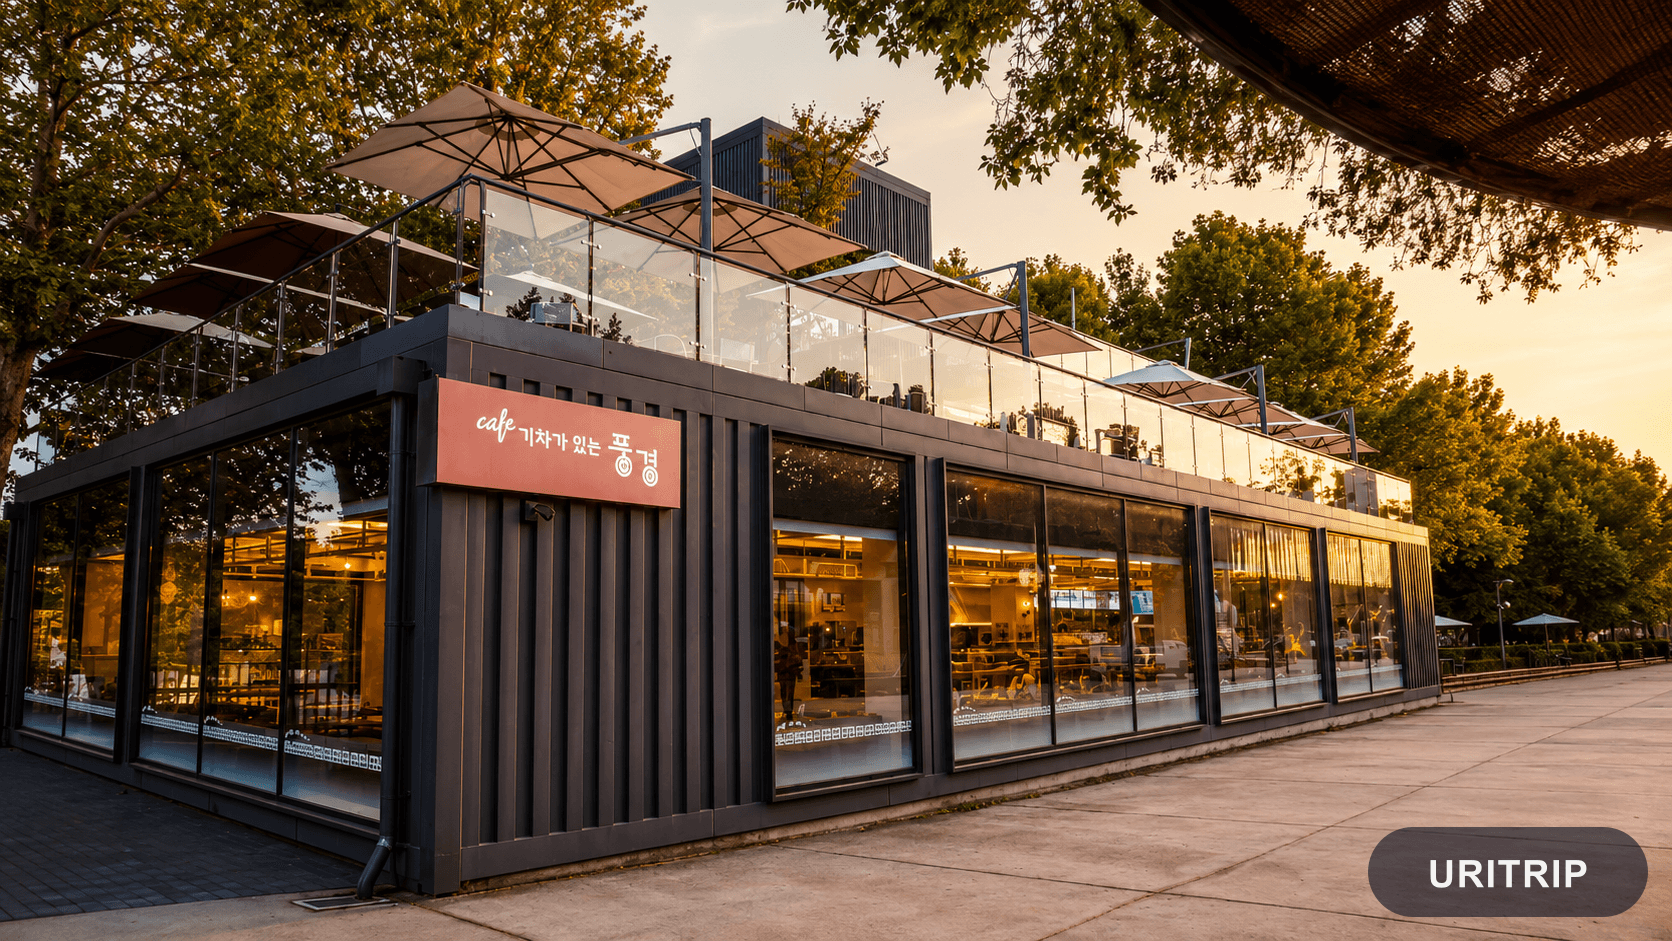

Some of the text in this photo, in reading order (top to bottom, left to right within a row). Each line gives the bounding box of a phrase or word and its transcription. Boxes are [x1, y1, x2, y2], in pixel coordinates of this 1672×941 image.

[476, 408, 659, 487] cafe 기차가 있는 풍경
